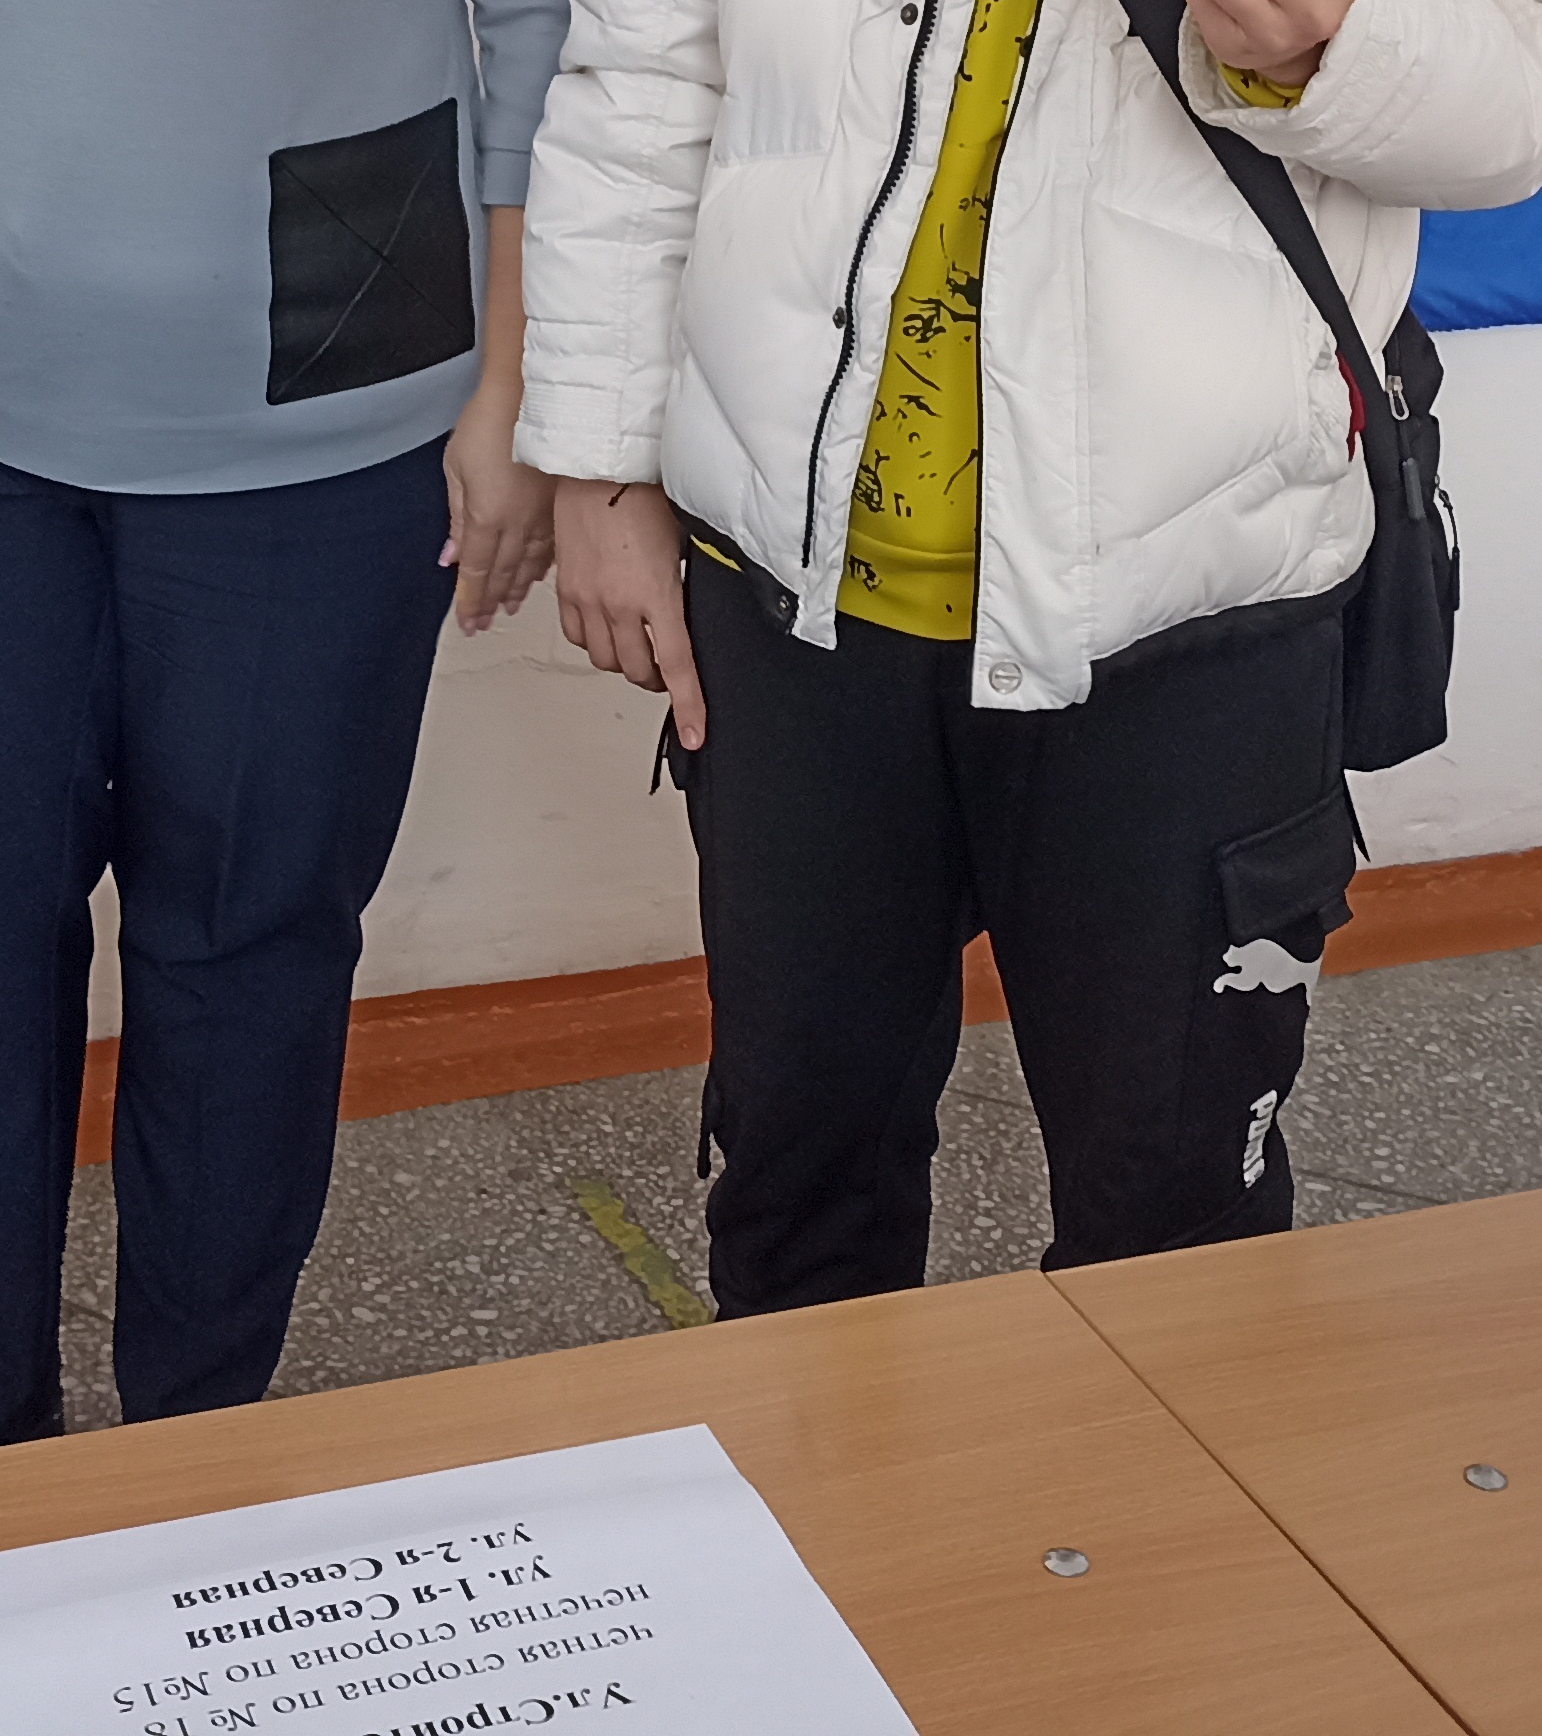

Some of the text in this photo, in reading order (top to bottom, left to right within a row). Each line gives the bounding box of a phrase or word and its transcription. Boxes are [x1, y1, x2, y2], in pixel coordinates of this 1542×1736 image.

[172, 1523, 532, 1609] ул. 2-я Северная
[185, 1555, 552, 1649] ул. 1-я Северная
[470, 1584, 650, 1633] нечетная
[290, 1622, 456, 1670] сторона
[518, 1625, 653, 1663] четная
[226, 1659, 278, 1682] по
[337, 1653, 504, 1700] сторона
[273, 1690, 325, 1713] по
